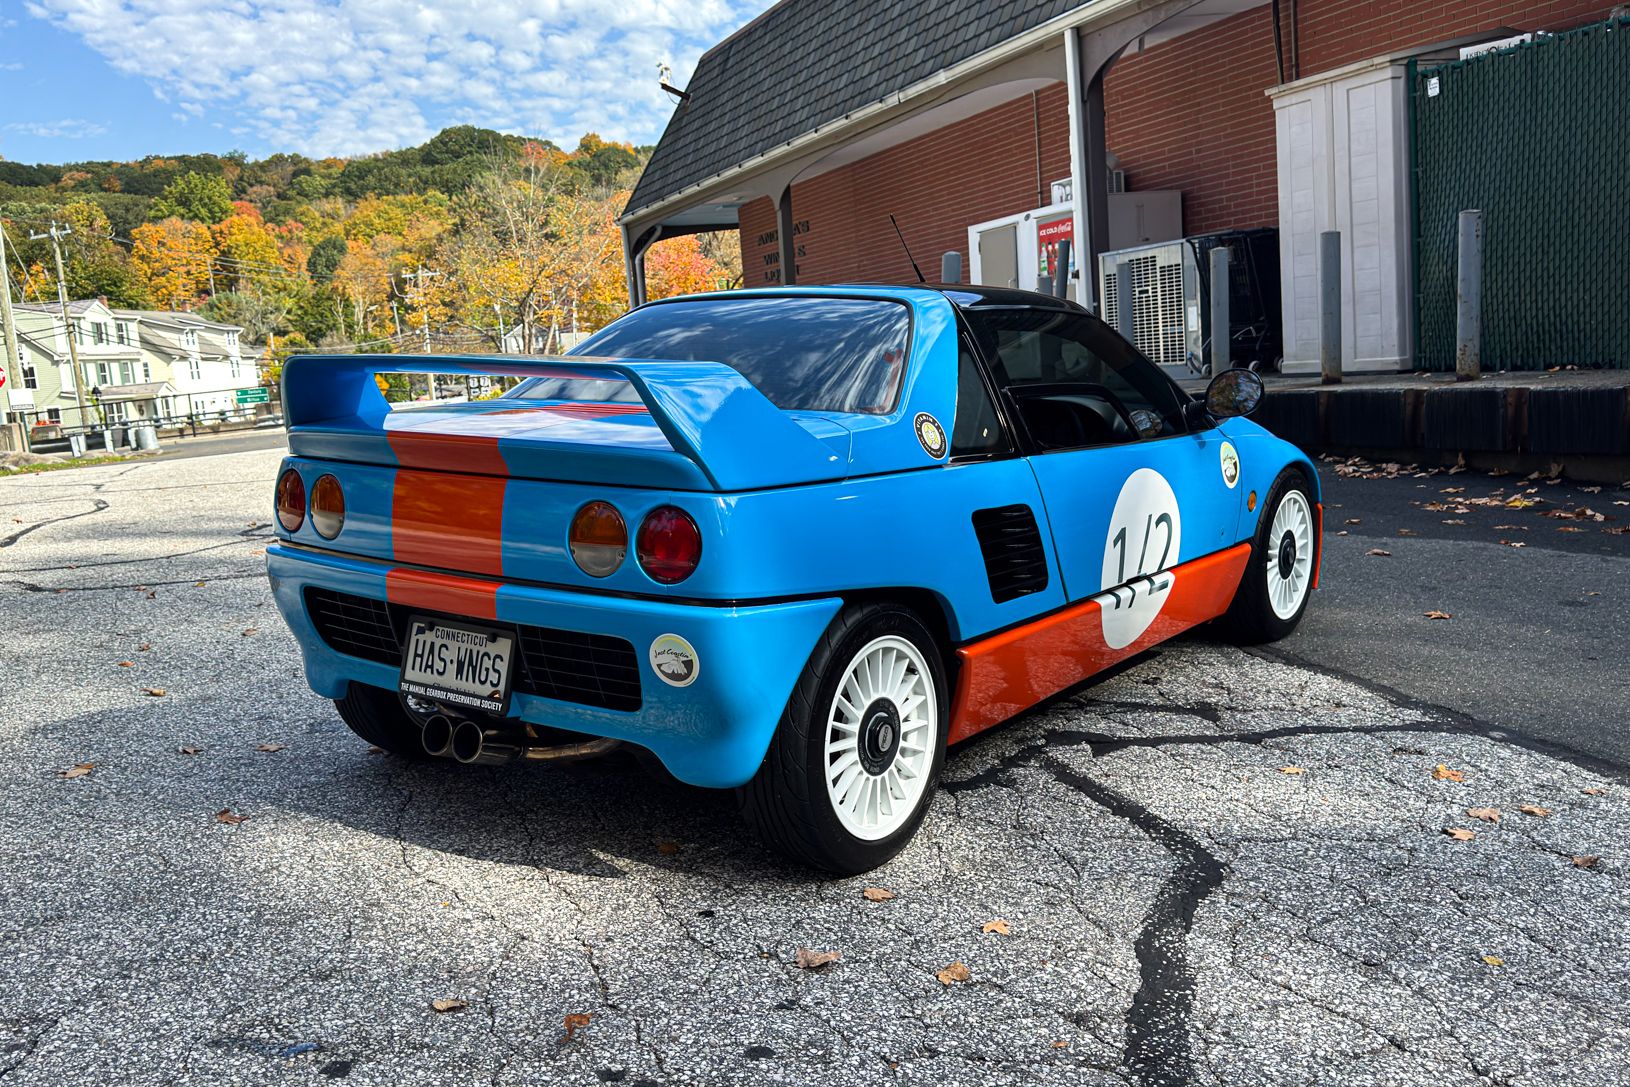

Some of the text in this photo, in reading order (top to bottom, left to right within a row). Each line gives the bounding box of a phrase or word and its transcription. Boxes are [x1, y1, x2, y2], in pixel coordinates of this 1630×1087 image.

[1046, 226, 1058, 234] COLD
[1113, 512, 1173, 610] 1/2
[435, 628, 488, 648] CONNECTICUT
[401, 682, 409, 691] THE
[409, 684, 426, 695] MANUAL
[426, 688, 446, 700] GEARBOX
[446, 692, 481, 707] PRESERVATION
[481, 700, 502, 712] SOCIETY
